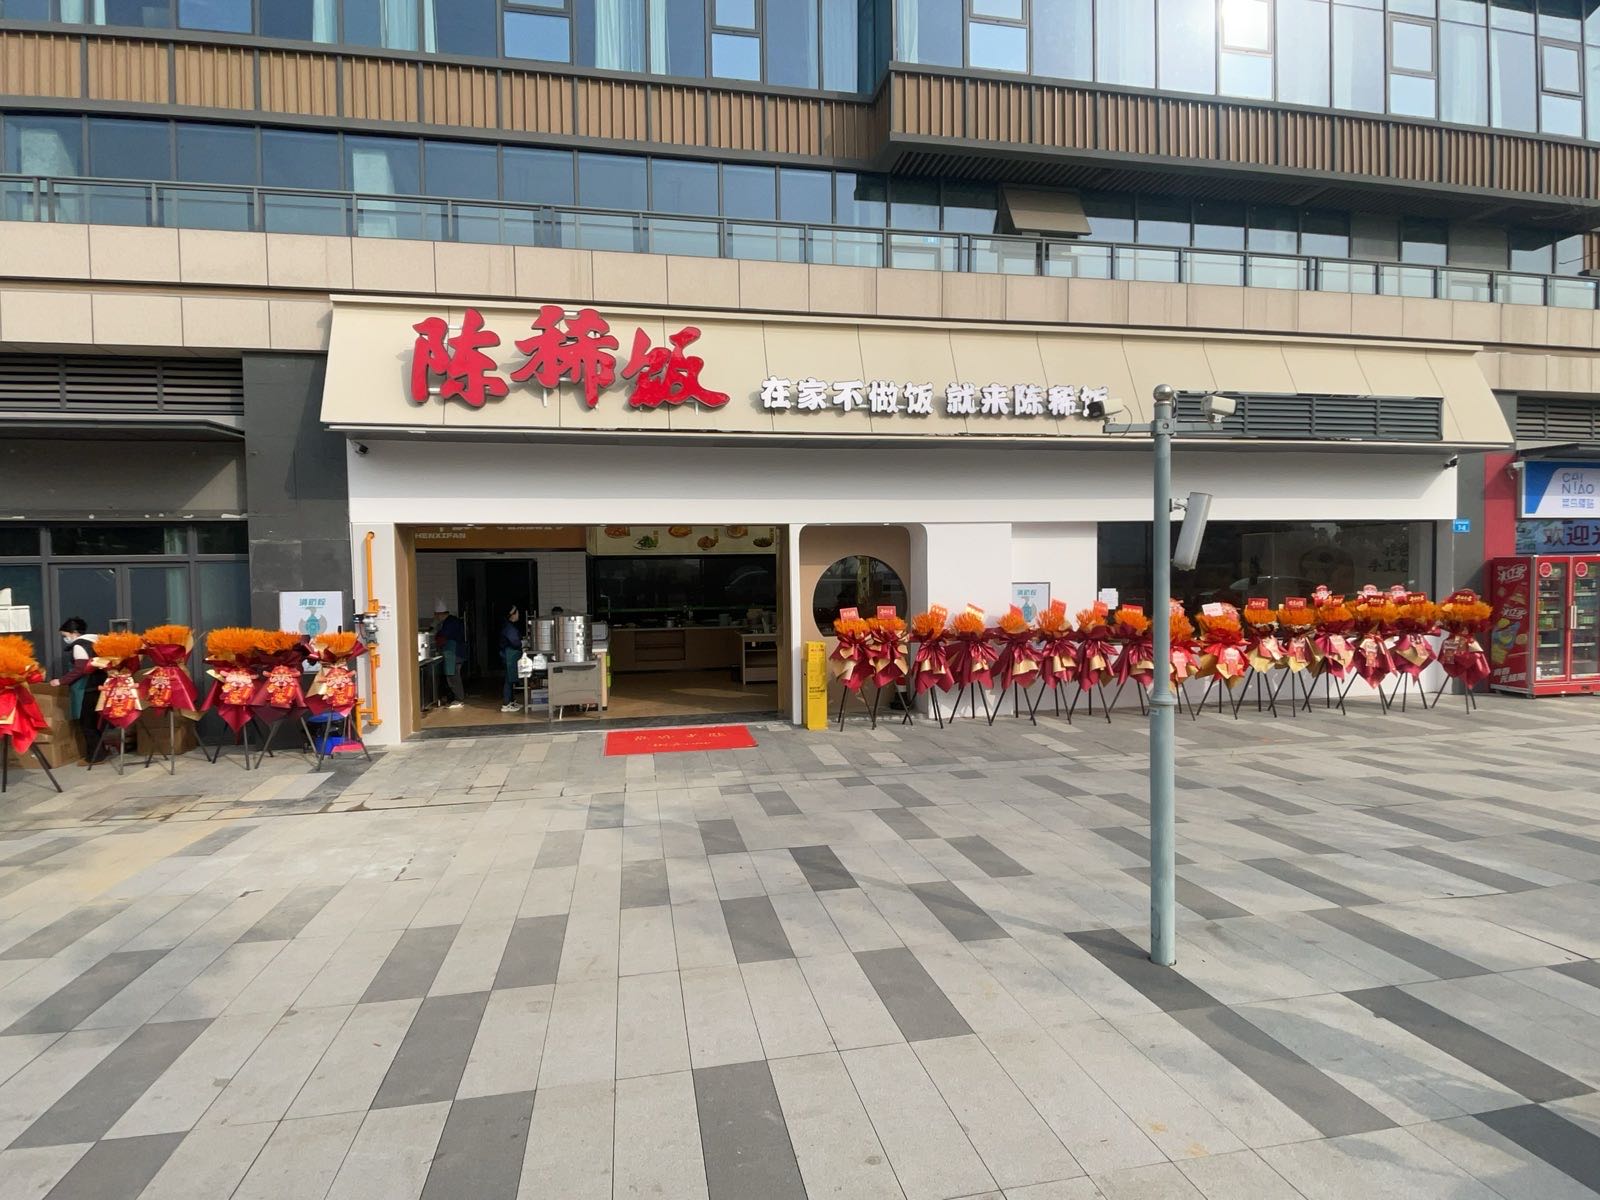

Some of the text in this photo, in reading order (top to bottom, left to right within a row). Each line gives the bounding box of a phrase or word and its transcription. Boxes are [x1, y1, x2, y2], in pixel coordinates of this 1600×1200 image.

[411, 305, 730, 408] 陈稀饭
[760, 376, 935, 415] 在家不做饭
